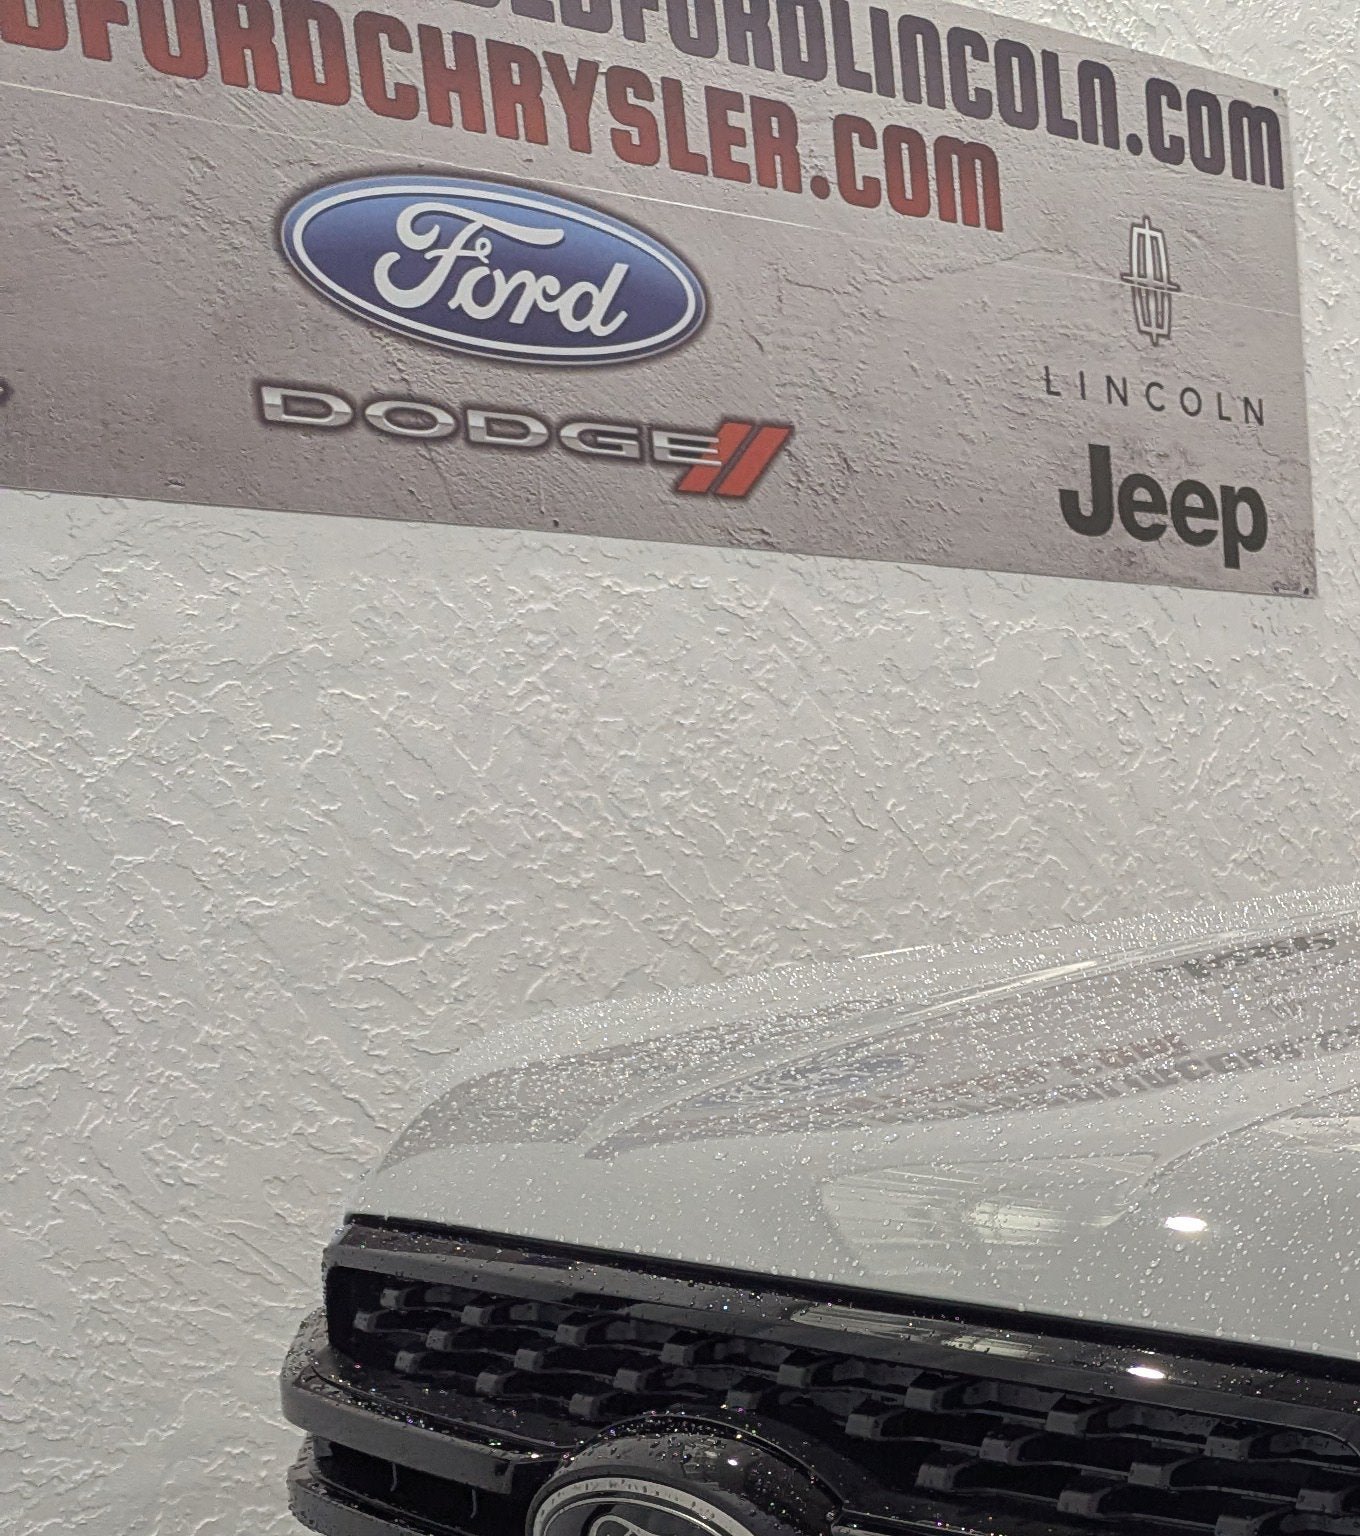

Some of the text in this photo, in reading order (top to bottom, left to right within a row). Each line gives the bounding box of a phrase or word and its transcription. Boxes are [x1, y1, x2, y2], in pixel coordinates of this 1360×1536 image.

[373, 201, 630, 337] Ford
[262, 386, 722, 468] DODGE
[1044, 365, 1264, 426] LINCOLN
[1058, 443, 1268, 569] Jeep
